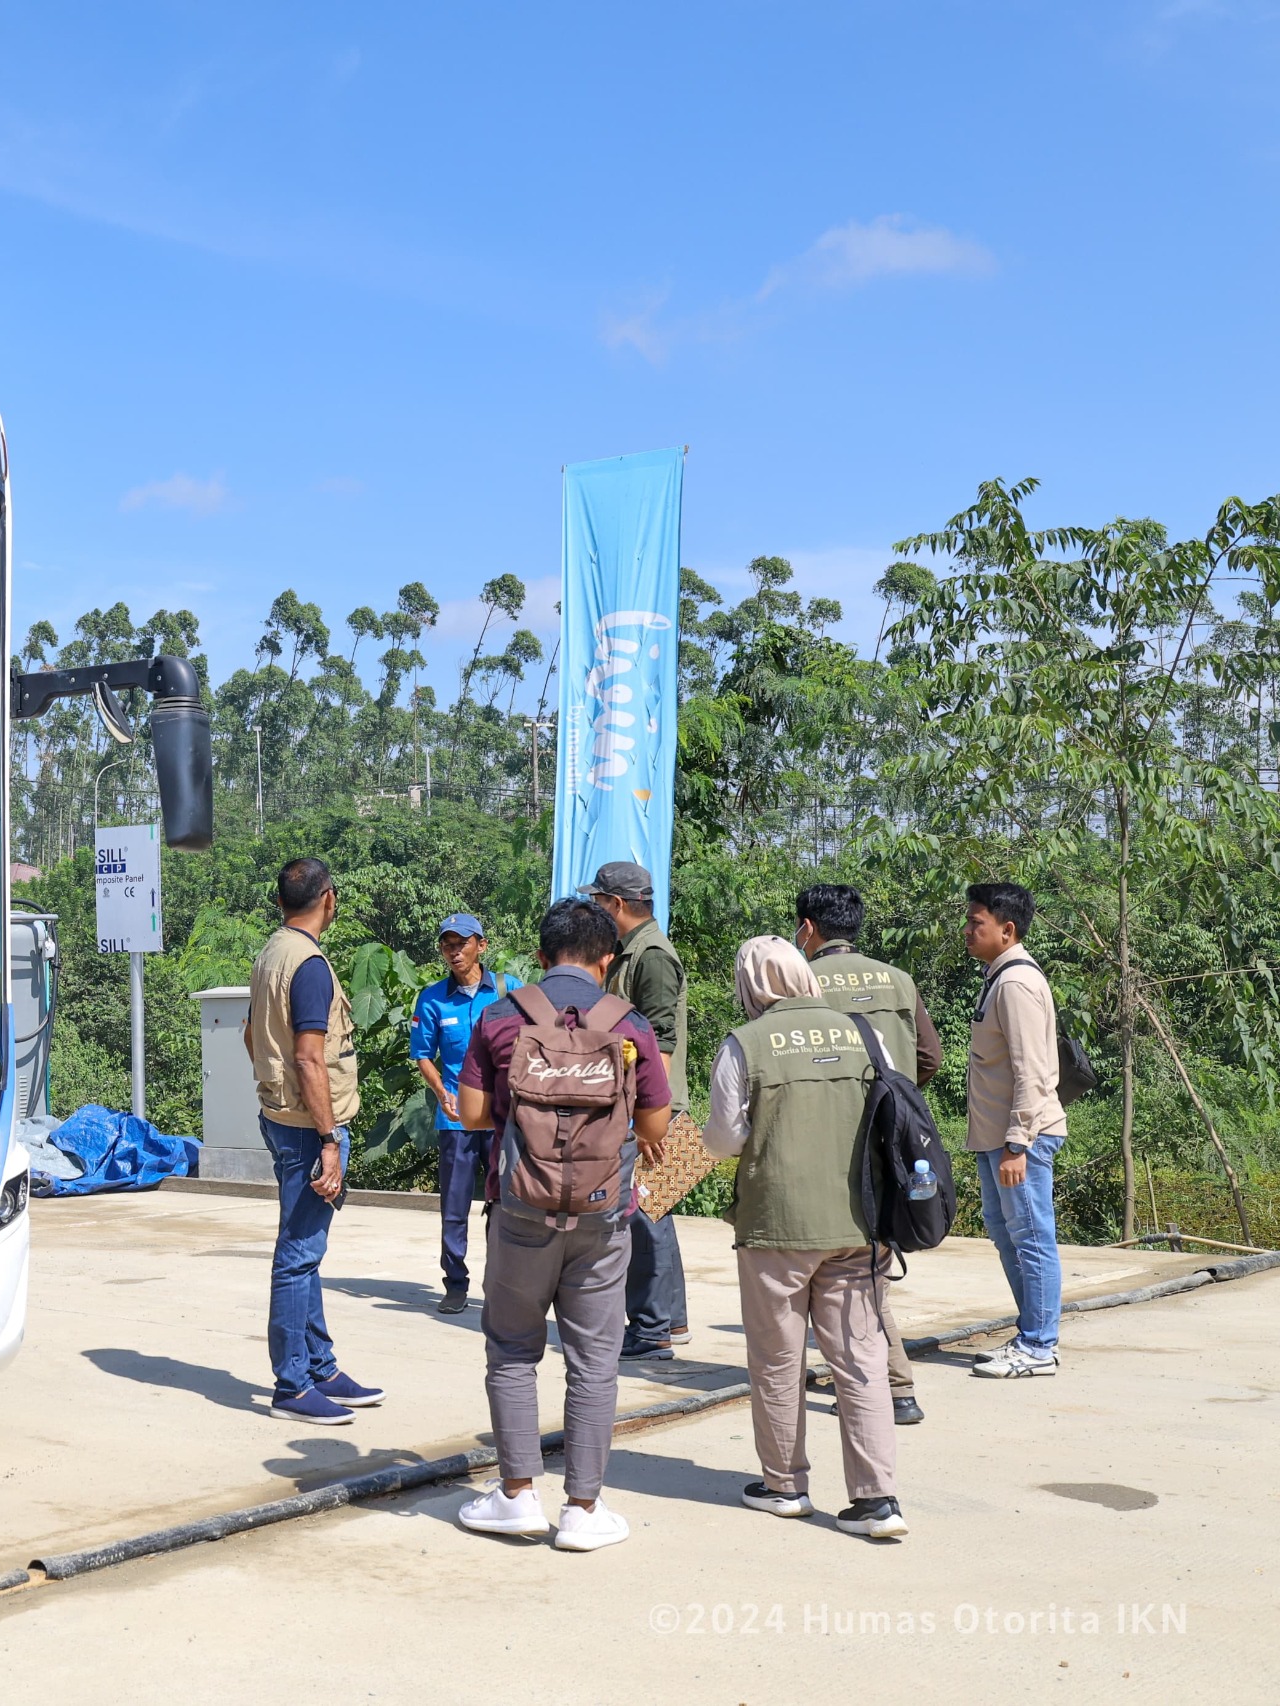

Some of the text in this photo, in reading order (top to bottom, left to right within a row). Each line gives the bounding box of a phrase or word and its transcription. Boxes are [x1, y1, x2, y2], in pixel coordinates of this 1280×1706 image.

[125, 874, 144, 883] Panel
[817, 971, 891, 988] DSBPM
[769, 1028, 862, 1049] DSBPM
[772, 1045, 800, 1057] Otorita
[801, 1045, 813, 1053] Ibu
[813, 1045, 831, 1053] Kota
